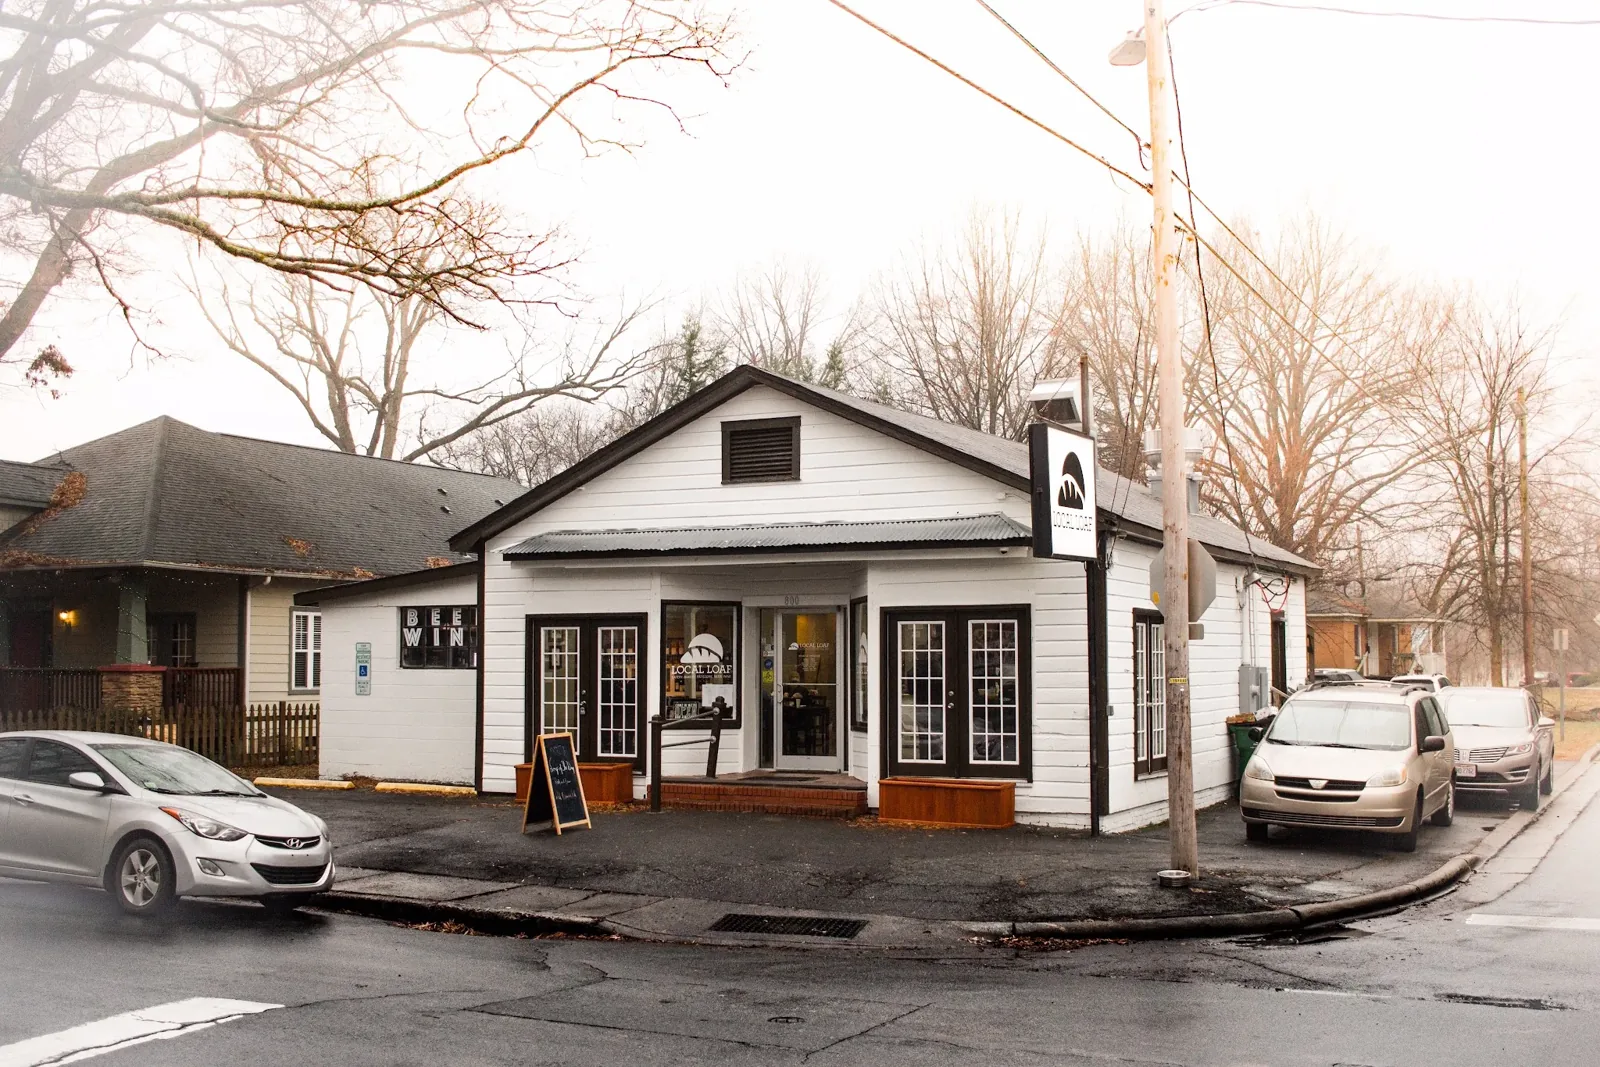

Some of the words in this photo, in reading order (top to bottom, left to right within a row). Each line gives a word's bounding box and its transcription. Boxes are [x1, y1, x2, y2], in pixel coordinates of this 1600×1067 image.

[1053, 511, 1075, 529] LOCAL
[1075, 515, 1093, 531] LOAF
[785, 596, 800, 605] 800
[671, 665, 704, 675] LOCAL
[706, 664, 733, 674] LOAF
